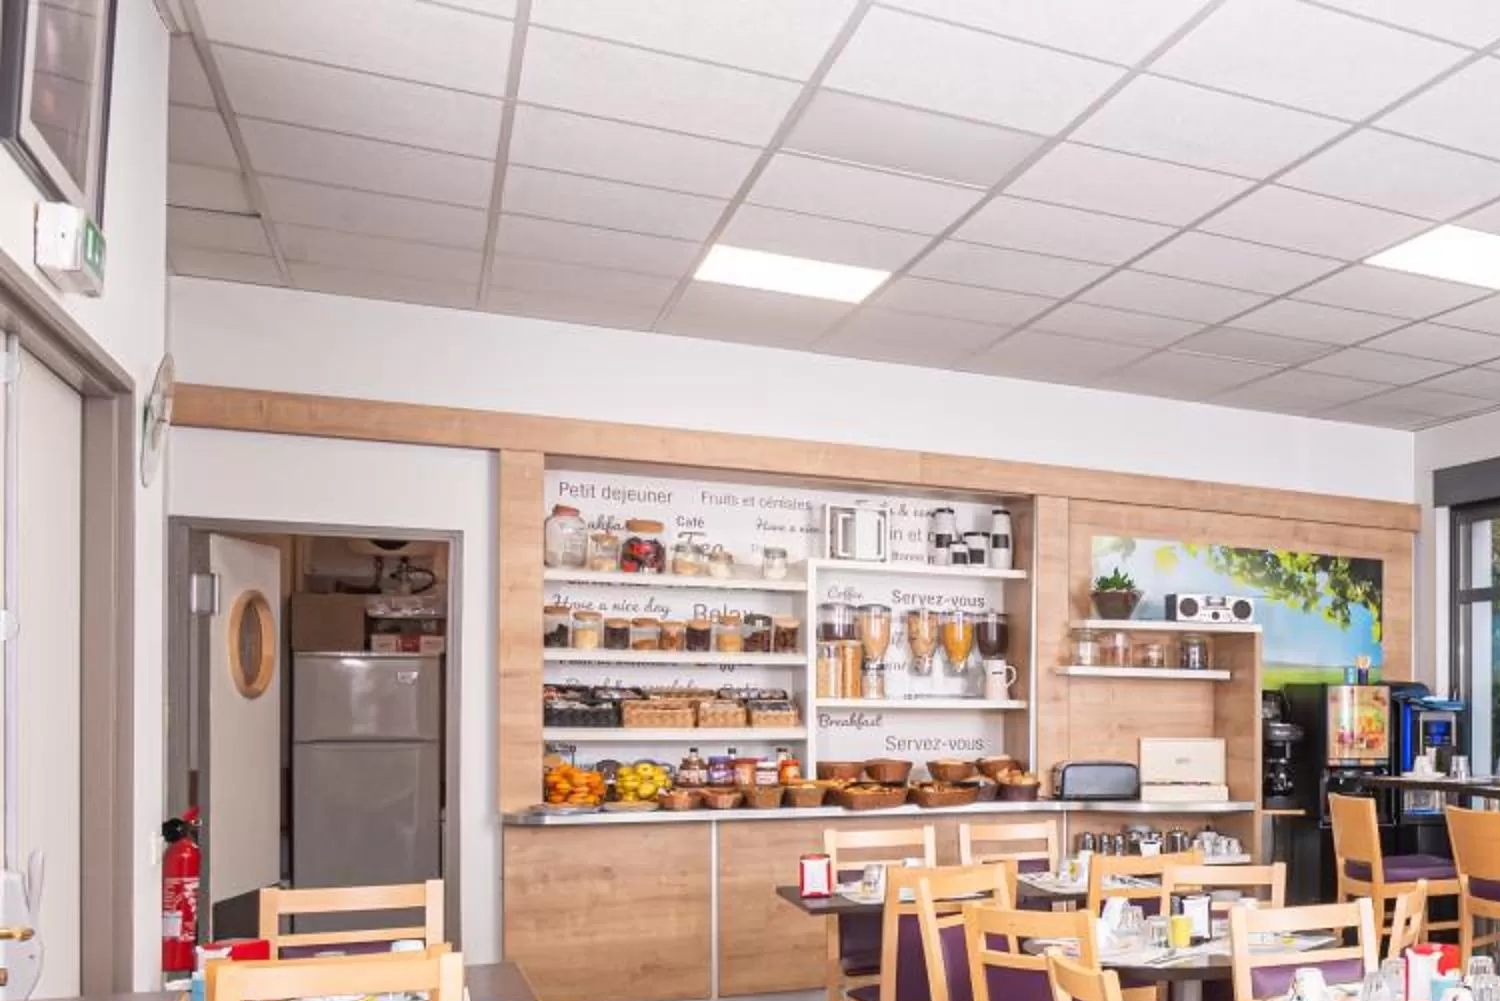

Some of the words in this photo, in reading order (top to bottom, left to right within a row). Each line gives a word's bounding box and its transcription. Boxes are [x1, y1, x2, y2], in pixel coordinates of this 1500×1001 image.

[559, 481, 597, 499] Petit
[701, 490, 739, 507] Fruits
[891, 589, 986, 608] Servez-vous
[819, 711, 882, 730] Breakfast
[885, 735, 985, 753] Servez-vous
